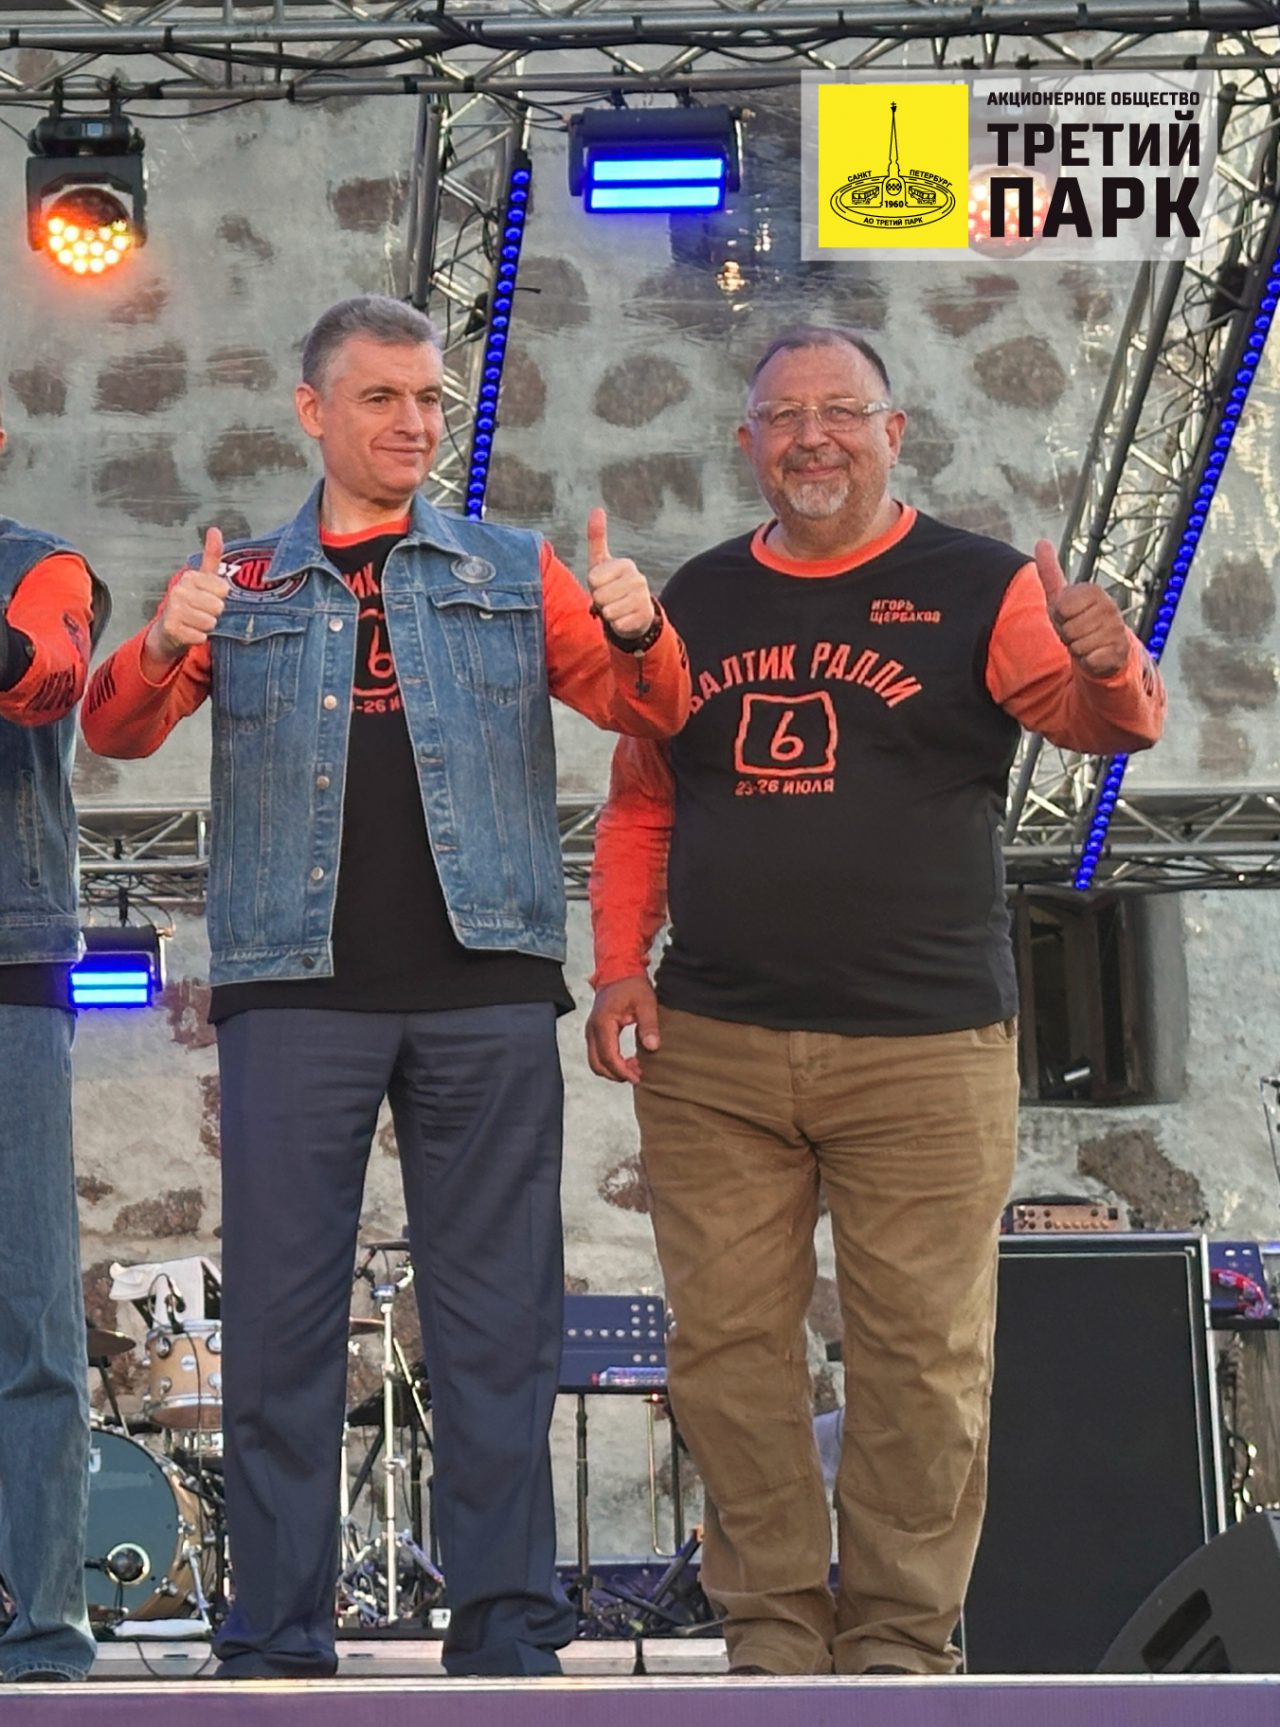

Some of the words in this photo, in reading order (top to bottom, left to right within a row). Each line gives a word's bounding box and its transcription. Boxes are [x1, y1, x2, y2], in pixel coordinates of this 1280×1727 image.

[871, 599, 914, 611] ИГОРЬ
[368, 624, 394, 678] 6
[809, 641, 922, 709] РАЛЛИ
[770, 710, 805, 762] 6
[782, 778, 835, 795] ИЮЛЯ
